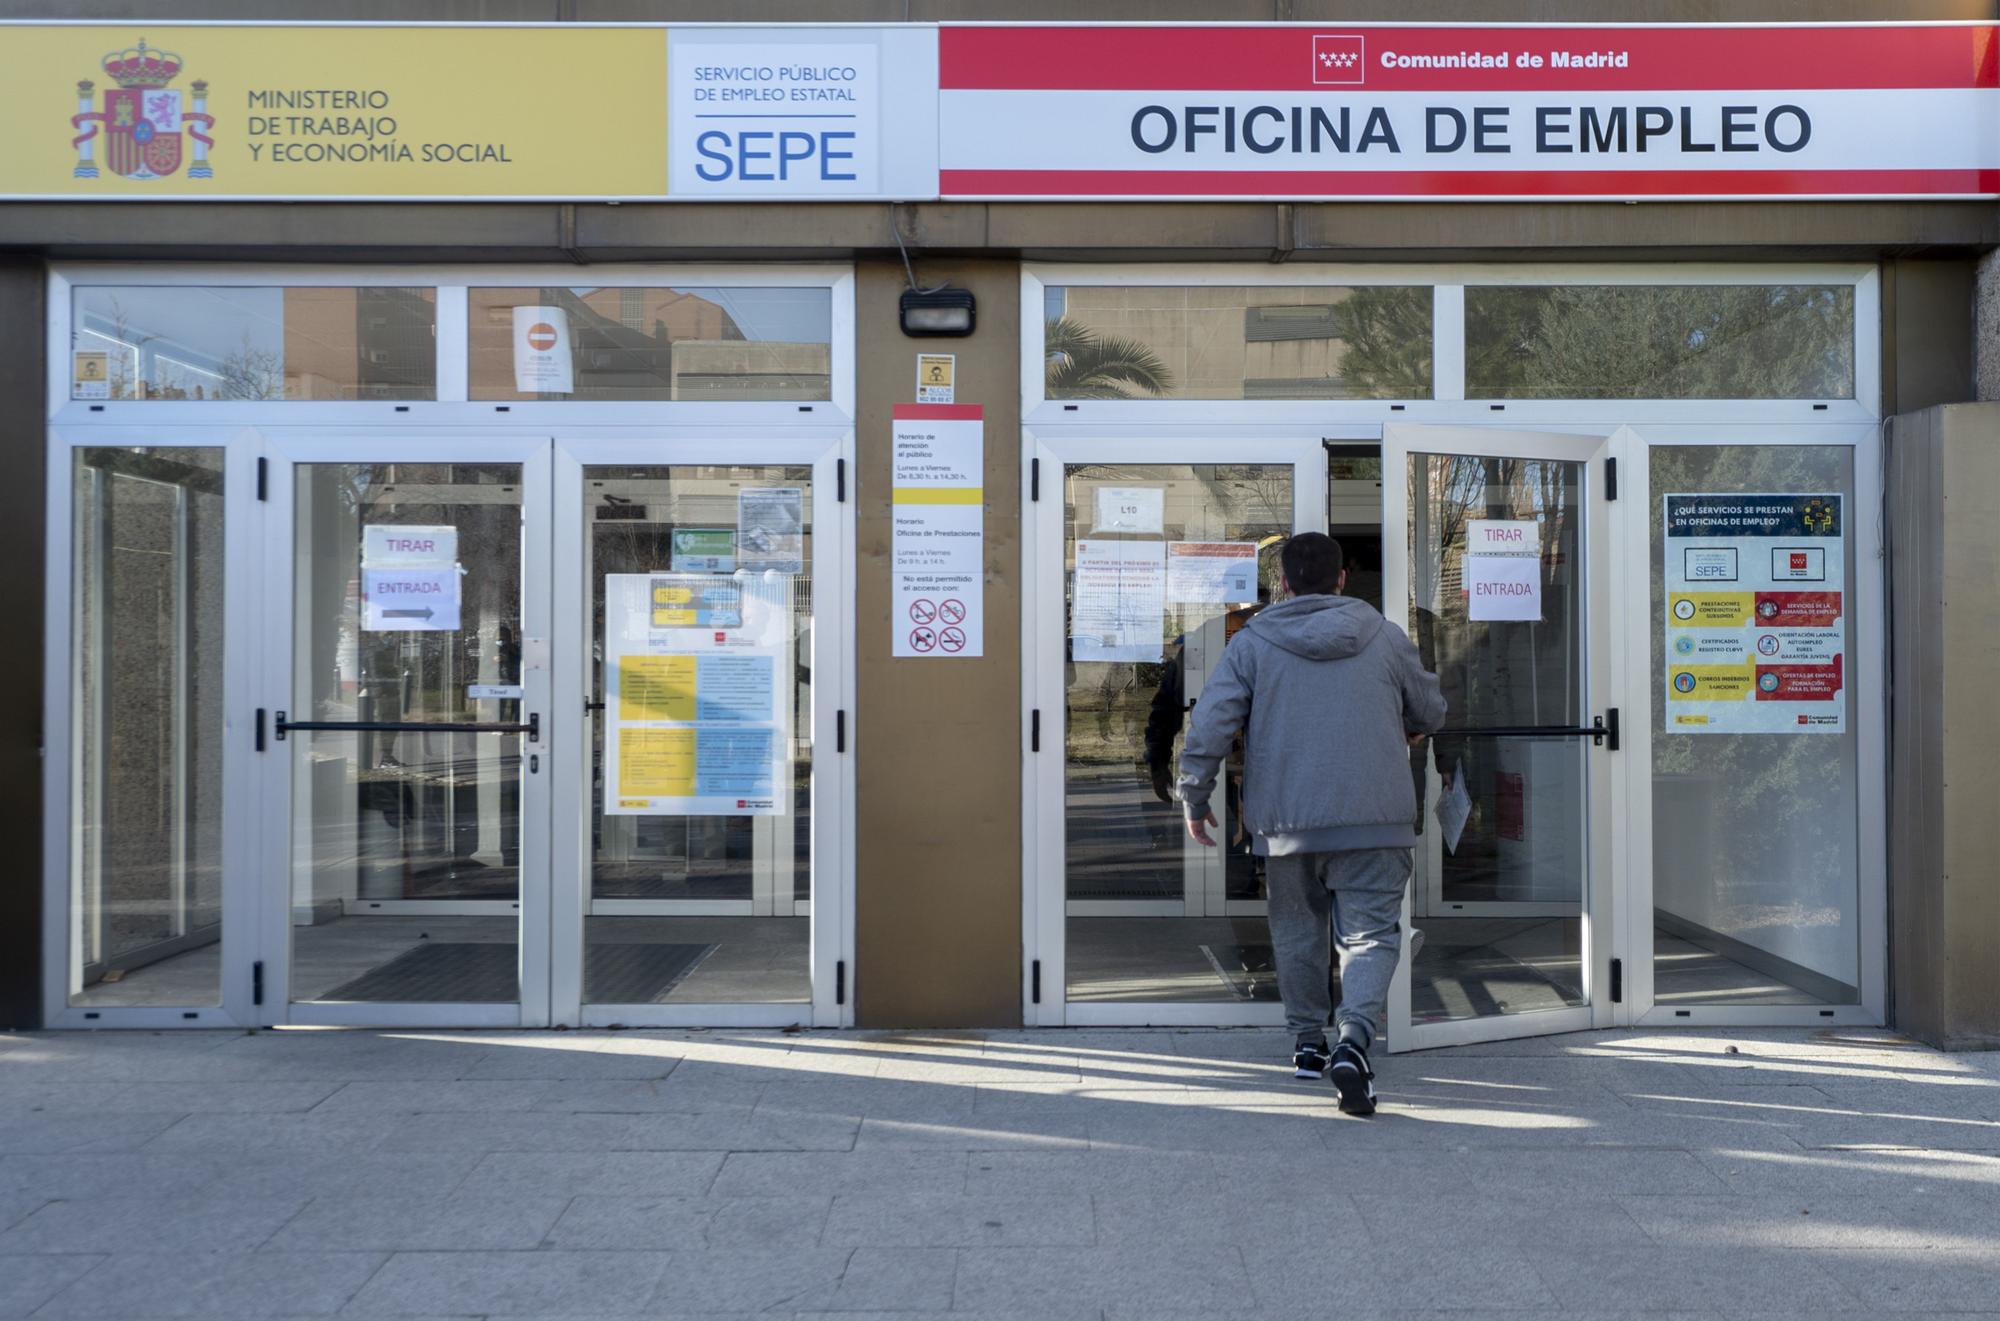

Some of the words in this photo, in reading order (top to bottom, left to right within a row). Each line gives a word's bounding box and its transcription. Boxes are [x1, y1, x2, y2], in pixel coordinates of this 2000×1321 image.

[1381, 50, 1508, 69] Comunidad
[1516, 50, 1543, 68] de
[1550, 50, 1628, 68] Madrid
[694, 66, 775, 81] SERVICIO
[779, 63, 857, 81] PÚBLICO
[248, 90, 389, 109] MINISTERIO
[694, 88, 718, 101] DE
[721, 88, 787, 102] EMPLEO
[790, 88, 857, 101] ESTATAL
[248, 117, 284, 136] DE
[287, 117, 398, 141] TRABAJO
[1131, 105, 1401, 154] OFICINA
[1424, 106, 1512, 154] DE
[1536, 104, 1813, 154] EMPLEO
[248, 143, 261, 162] Y
[272, 139, 414, 163] ECONOMÍA
[421, 142, 512, 163] SOCIAL
[695, 131, 857, 182] SEPE
[906, 451, 933, 459] público
[1120, 505, 1138, 514] L10
[1674, 505, 1696, 516] ¿QUÉ
[1698, 506, 1742, 514] SERVICIOS
[1744, 506, 1755, 514] SE
[1756, 506, 1794, 514] PRESTAN
[1675, 518, 1687, 526] EN
[1689, 518, 1729, 526] OFICINAS
[1730, 518, 1741, 526] DE
[1742, 518, 1780, 526] EMPLEO?
[1484, 529, 1522, 541] TIRAR
[386, 539, 435, 552] TIRAR
[1696, 566, 1727, 577] SEPE
[935, 575, 973, 584] permitido
[377, 582, 442, 594] ENTRADA
[1476, 583, 1533, 596] ENTRADA
